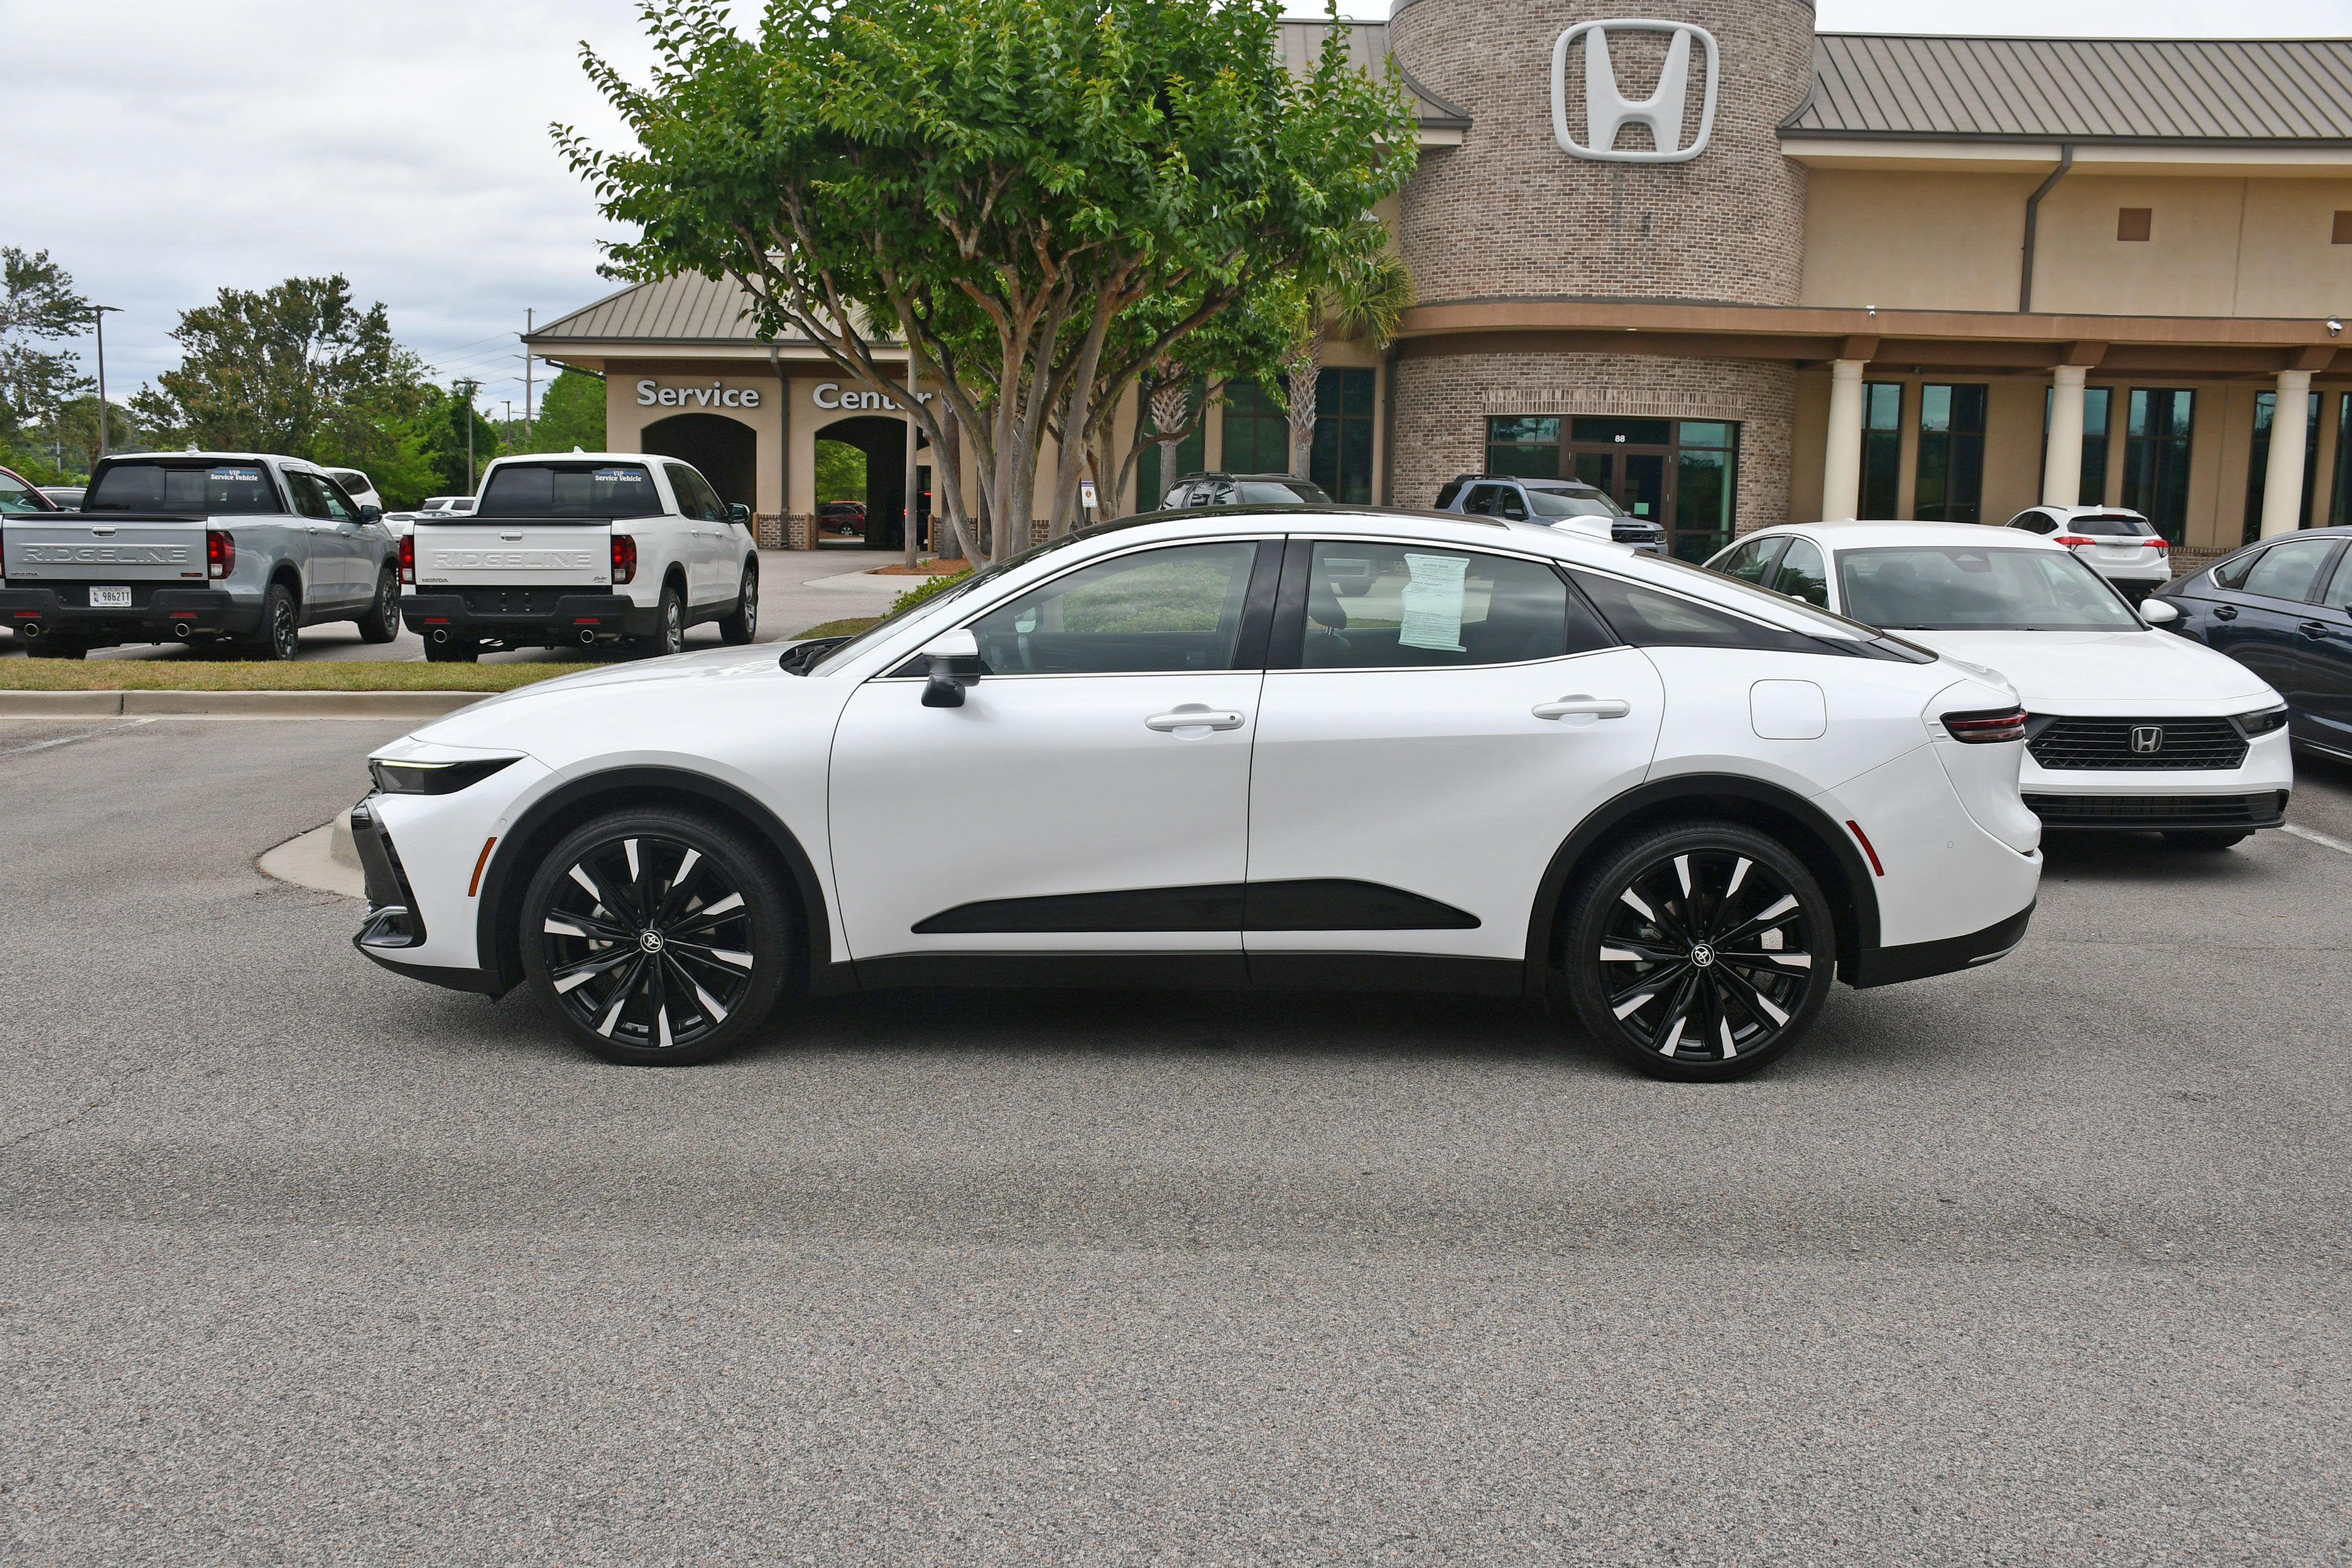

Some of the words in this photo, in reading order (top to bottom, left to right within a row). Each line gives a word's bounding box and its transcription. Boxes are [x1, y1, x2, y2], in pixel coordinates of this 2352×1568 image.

[635, 380, 760, 408] Service
[812, 383, 933, 410] Centr
[23, 546, 188, 562] RIDGELINE
[433, 553, 592, 567] RIDGELINE
[103, 592, 130, 601] 9862TT
